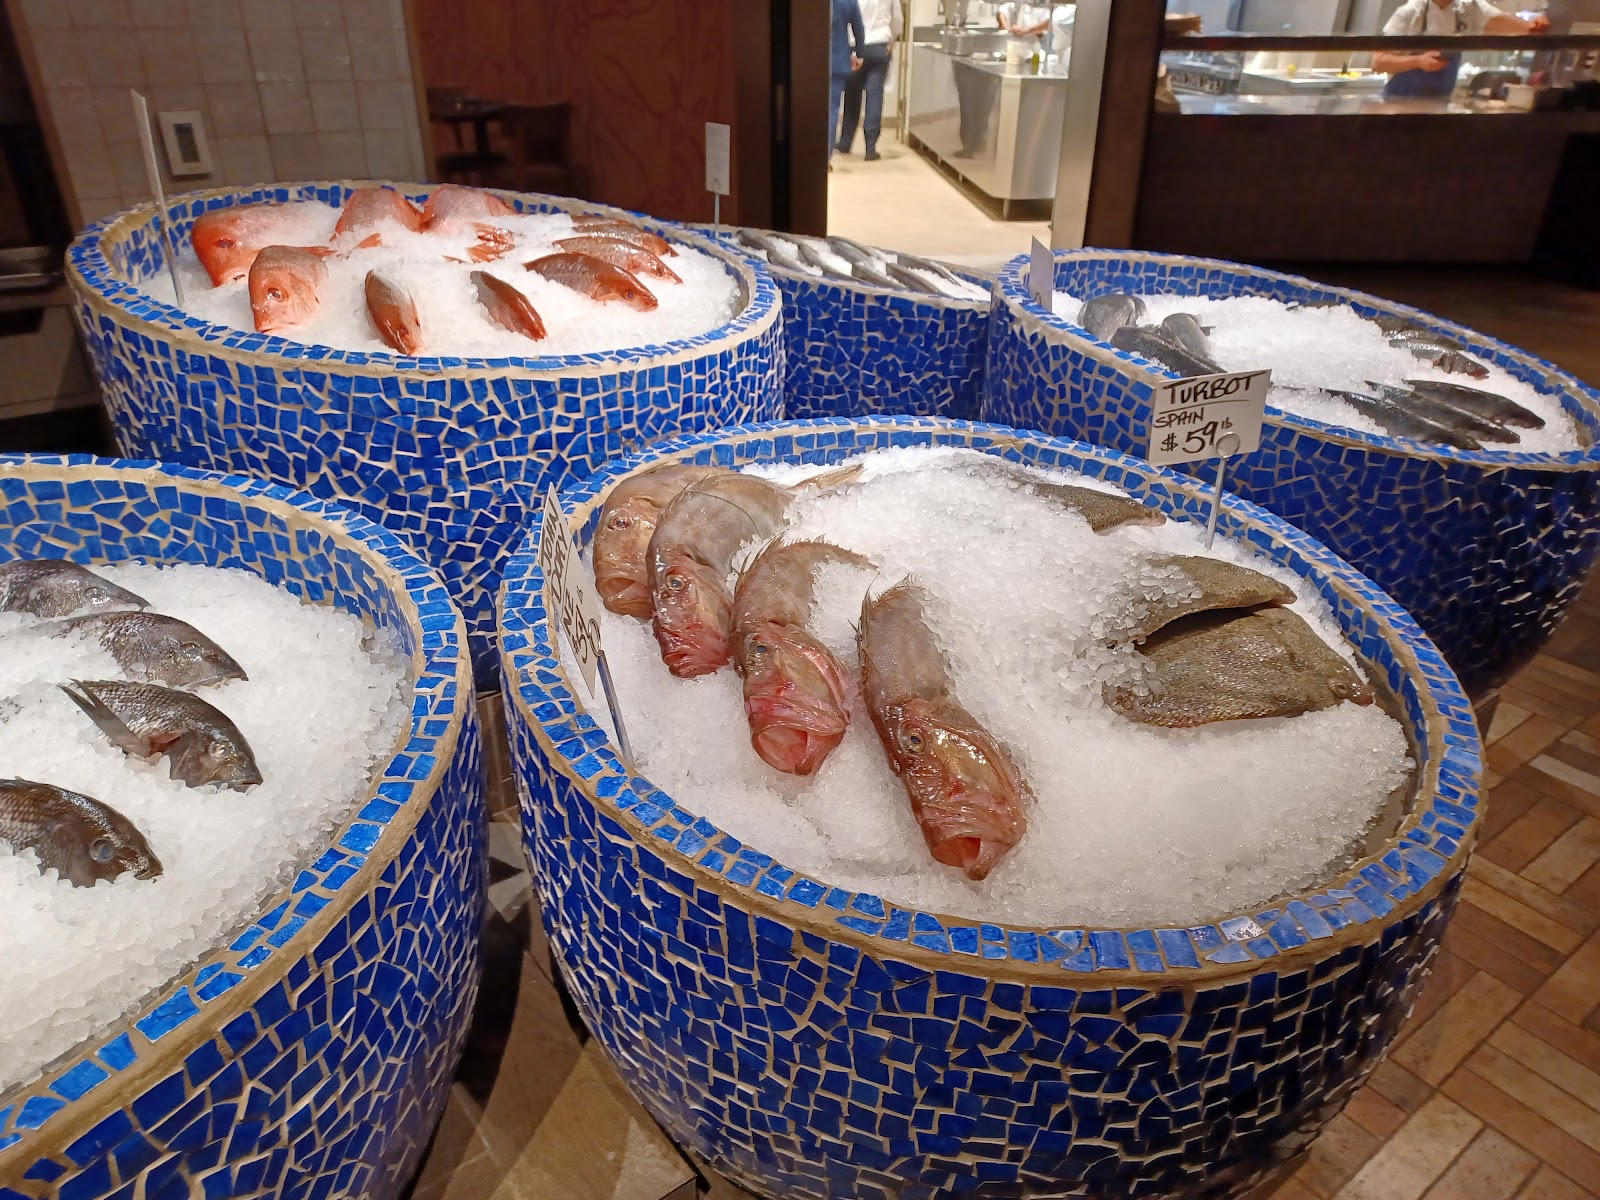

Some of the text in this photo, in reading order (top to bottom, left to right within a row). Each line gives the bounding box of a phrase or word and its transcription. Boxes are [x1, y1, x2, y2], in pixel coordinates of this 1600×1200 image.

[1163, 371, 1267, 405] TURBOT
[1153, 407, 1204, 429] SPAIN
[541, 496, 559, 577] JOHN
[550, 522, 568, 605] DORY
